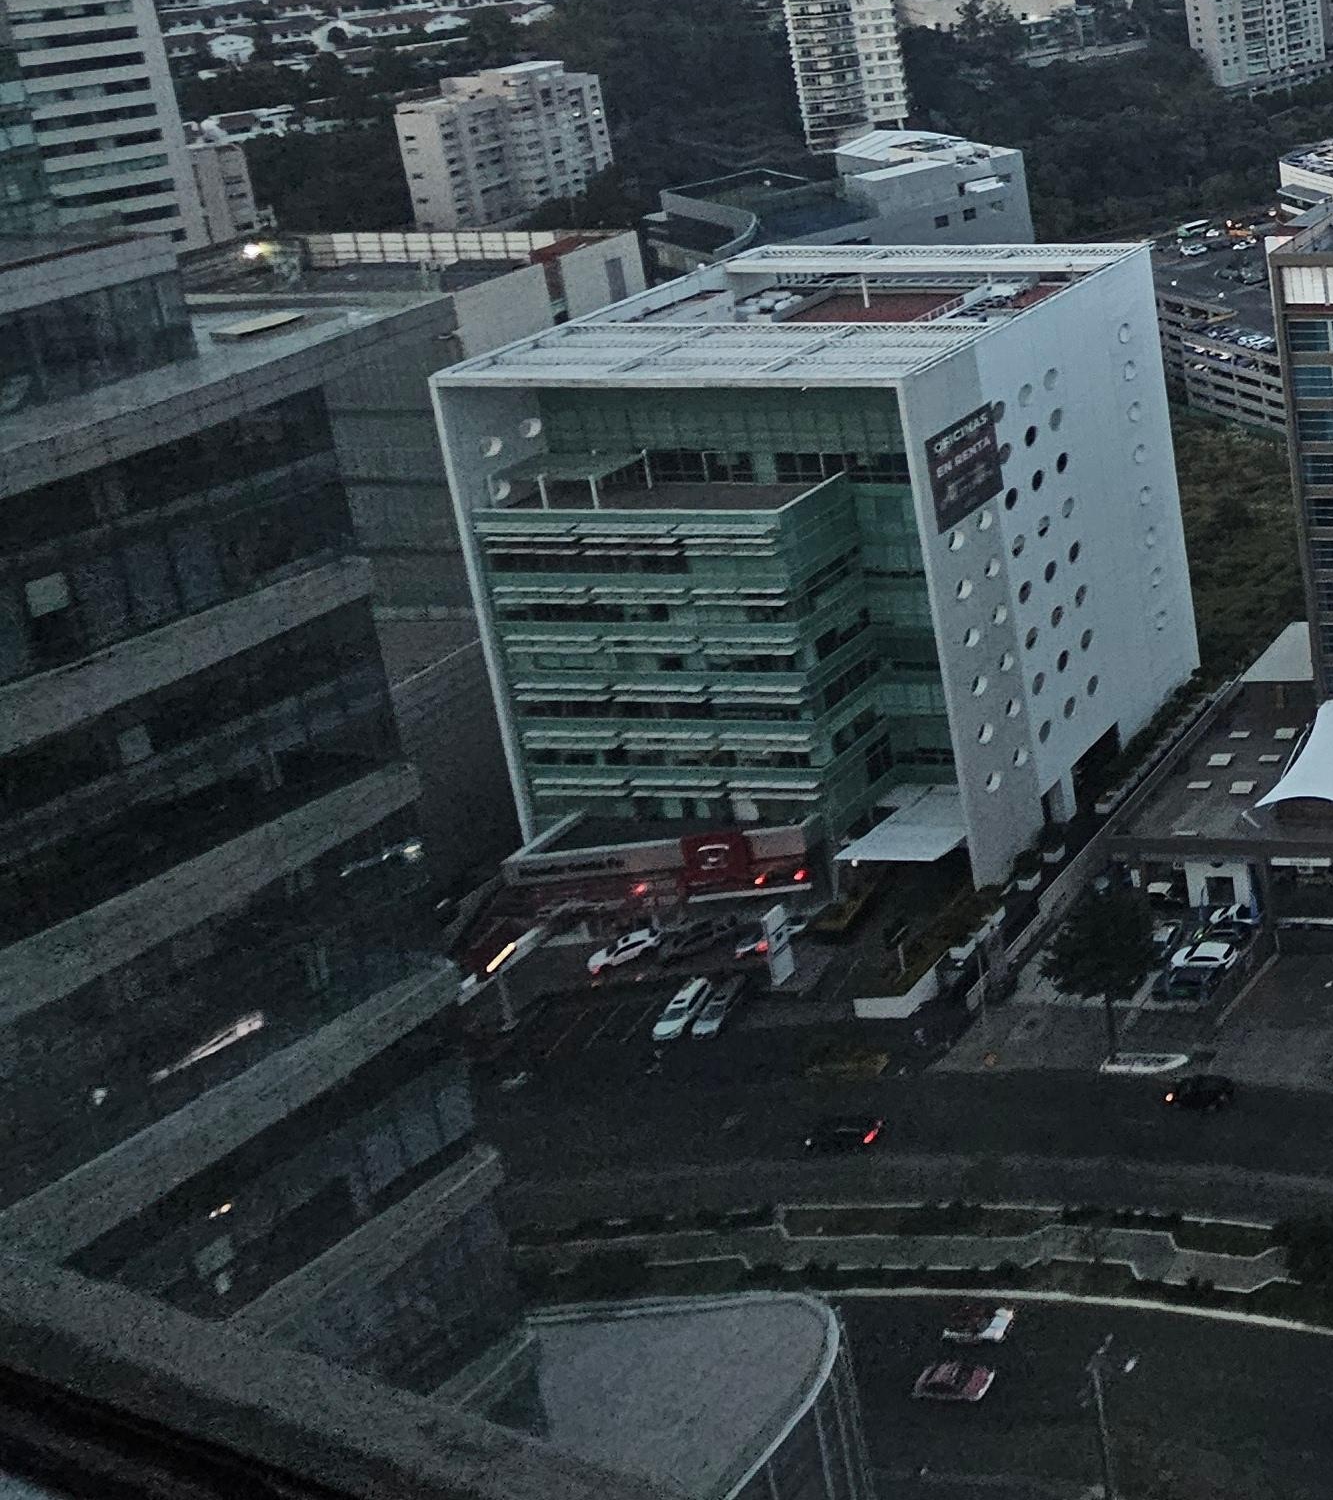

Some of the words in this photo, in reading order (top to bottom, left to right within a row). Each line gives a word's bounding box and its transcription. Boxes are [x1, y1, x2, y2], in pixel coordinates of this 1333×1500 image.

[934, 412, 988, 454] OFICINAS
[936, 461, 953, 478] EN
[954, 436, 991, 467] RENTA
